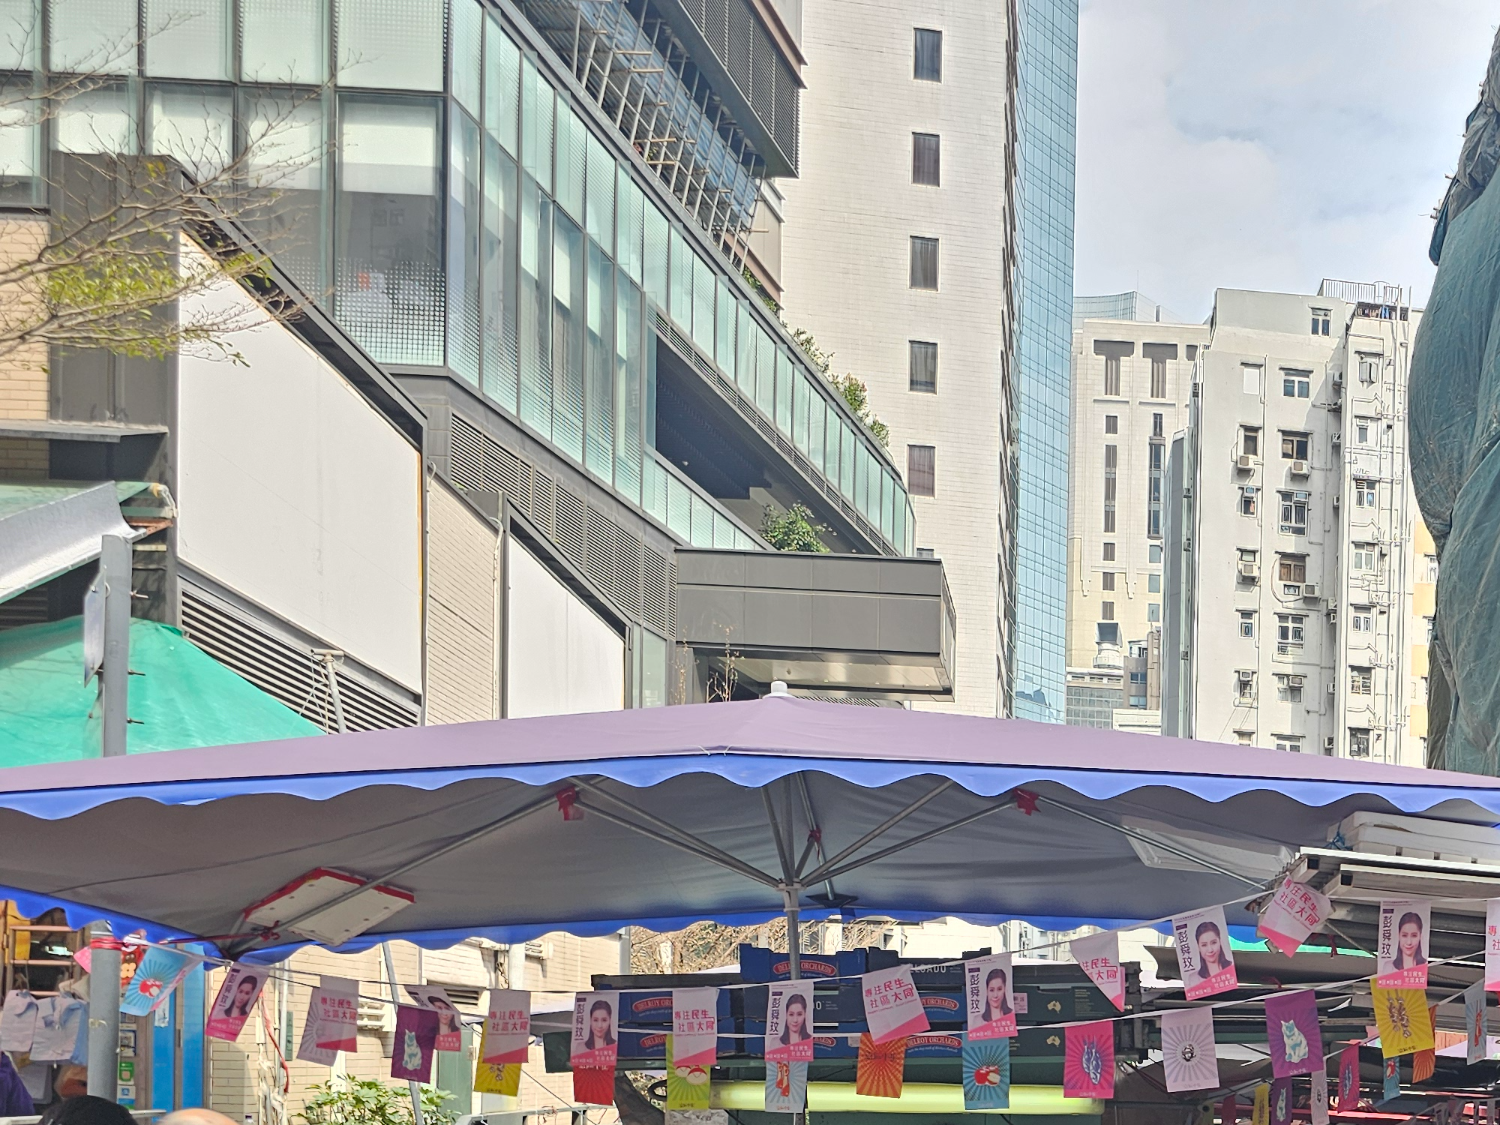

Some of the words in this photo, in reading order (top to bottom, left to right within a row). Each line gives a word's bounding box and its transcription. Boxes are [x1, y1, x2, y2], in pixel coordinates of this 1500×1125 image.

[1279, 891, 1321, 927] 社區大同
[1178, 930, 1195, 969] 彭舜玟
[1381, 915, 1393, 956] 彭舜玟
[1079, 957, 1111, 971] 注民生
[865, 978, 905, 999] 專注民生
[870, 984, 915, 1009] 社區大同
[969, 973, 981, 1011] 彭舜玟
[674, 1009, 709, 1020] 專注民生
[769, 997, 780, 1036] 彭舜玟
[929, 1036, 961, 1047] ORCHARDS
